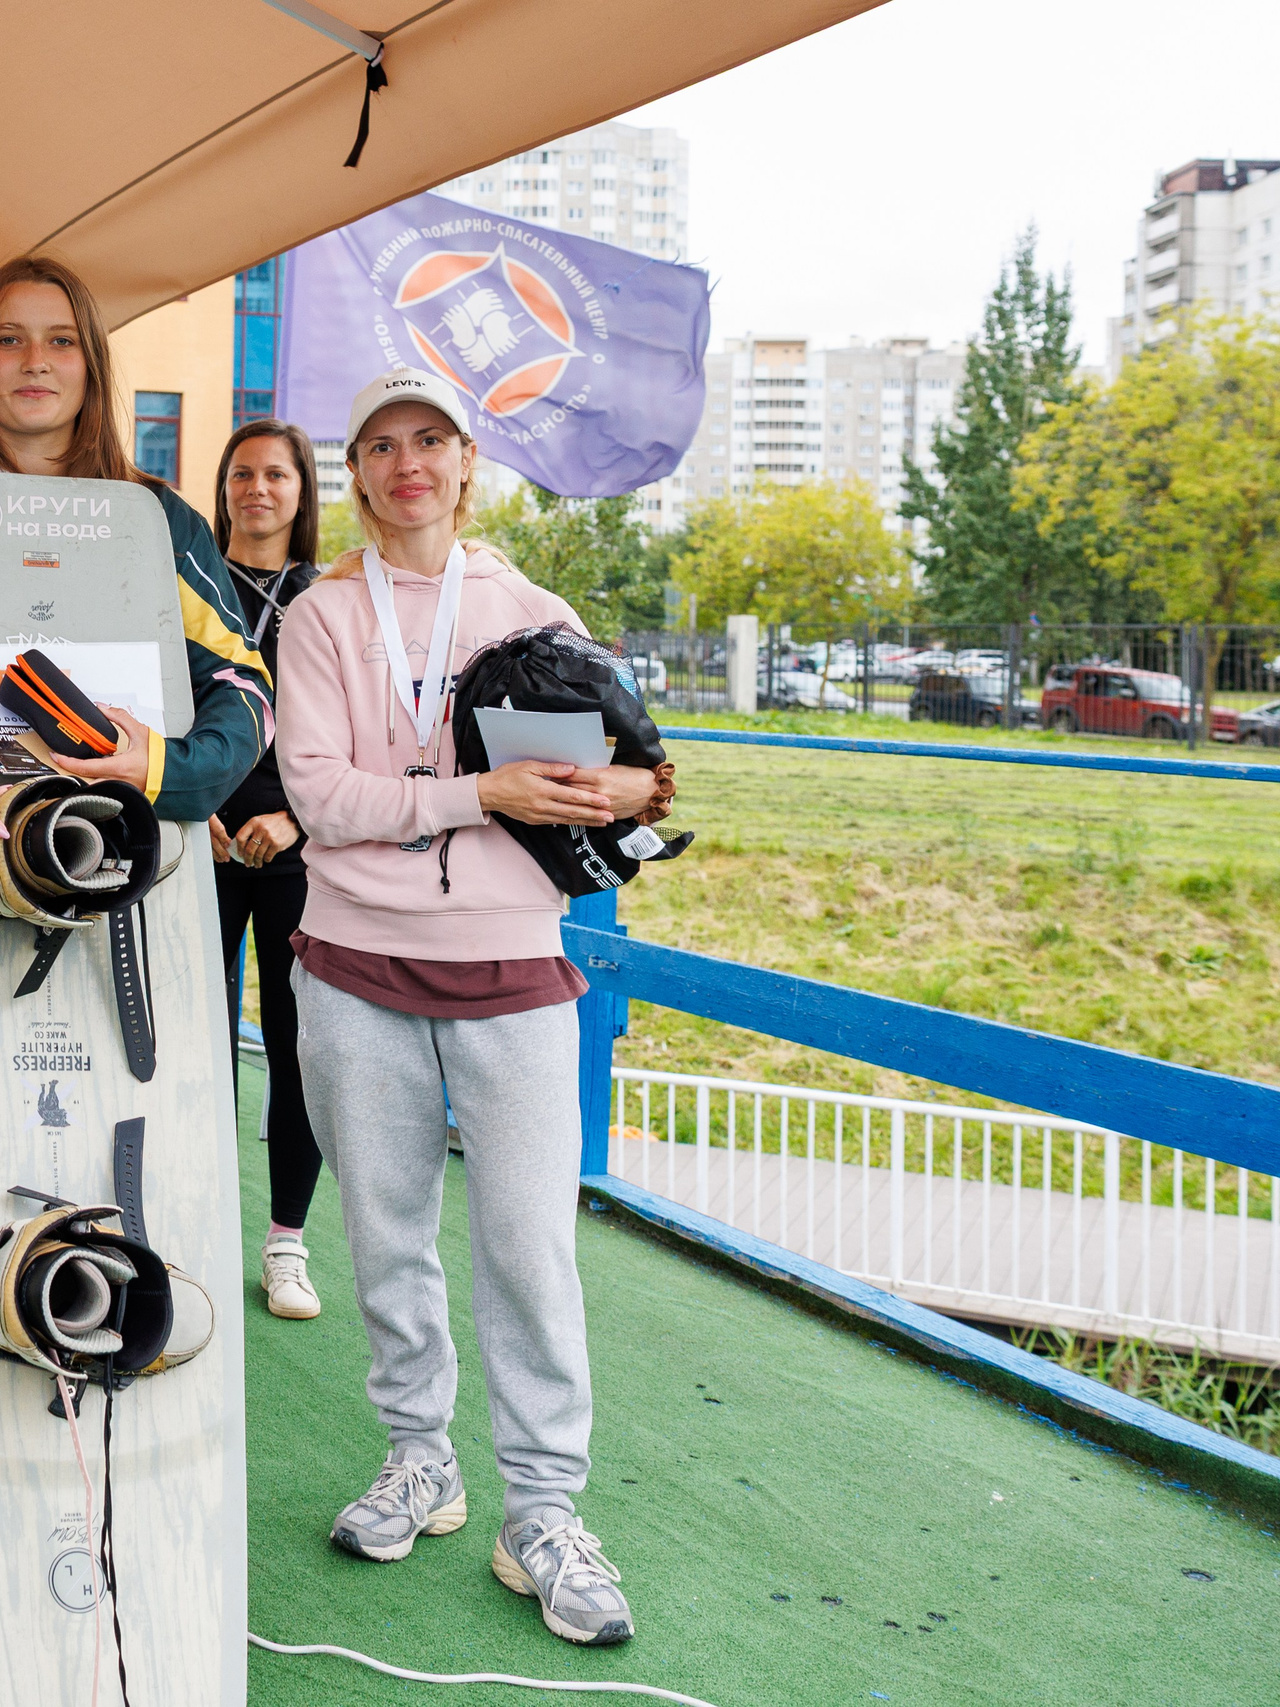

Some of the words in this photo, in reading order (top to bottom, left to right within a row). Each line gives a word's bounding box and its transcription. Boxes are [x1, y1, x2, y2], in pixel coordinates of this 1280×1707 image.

[421, 218, 596, 298] ПОЖАРНО-СПАСАТЕЛЬНЫЙ
[584, 299, 609, 340] ЦЕНТР
[477, 384, 592, 445] БЕЗПАСНОСТЬ»
[7, 495, 111, 518] КРУГИ
[7, 521, 40, 536] на
[46, 522, 112, 541] воде
[34, 1031, 44, 1039] CO
[46, 1031, 67, 1039] WAKE
[21, 1042, 82, 1053] HYPERLITE
[12, 1055, 91, 1072] FREEPRESS
[83, 1584, 93, 1596] H
